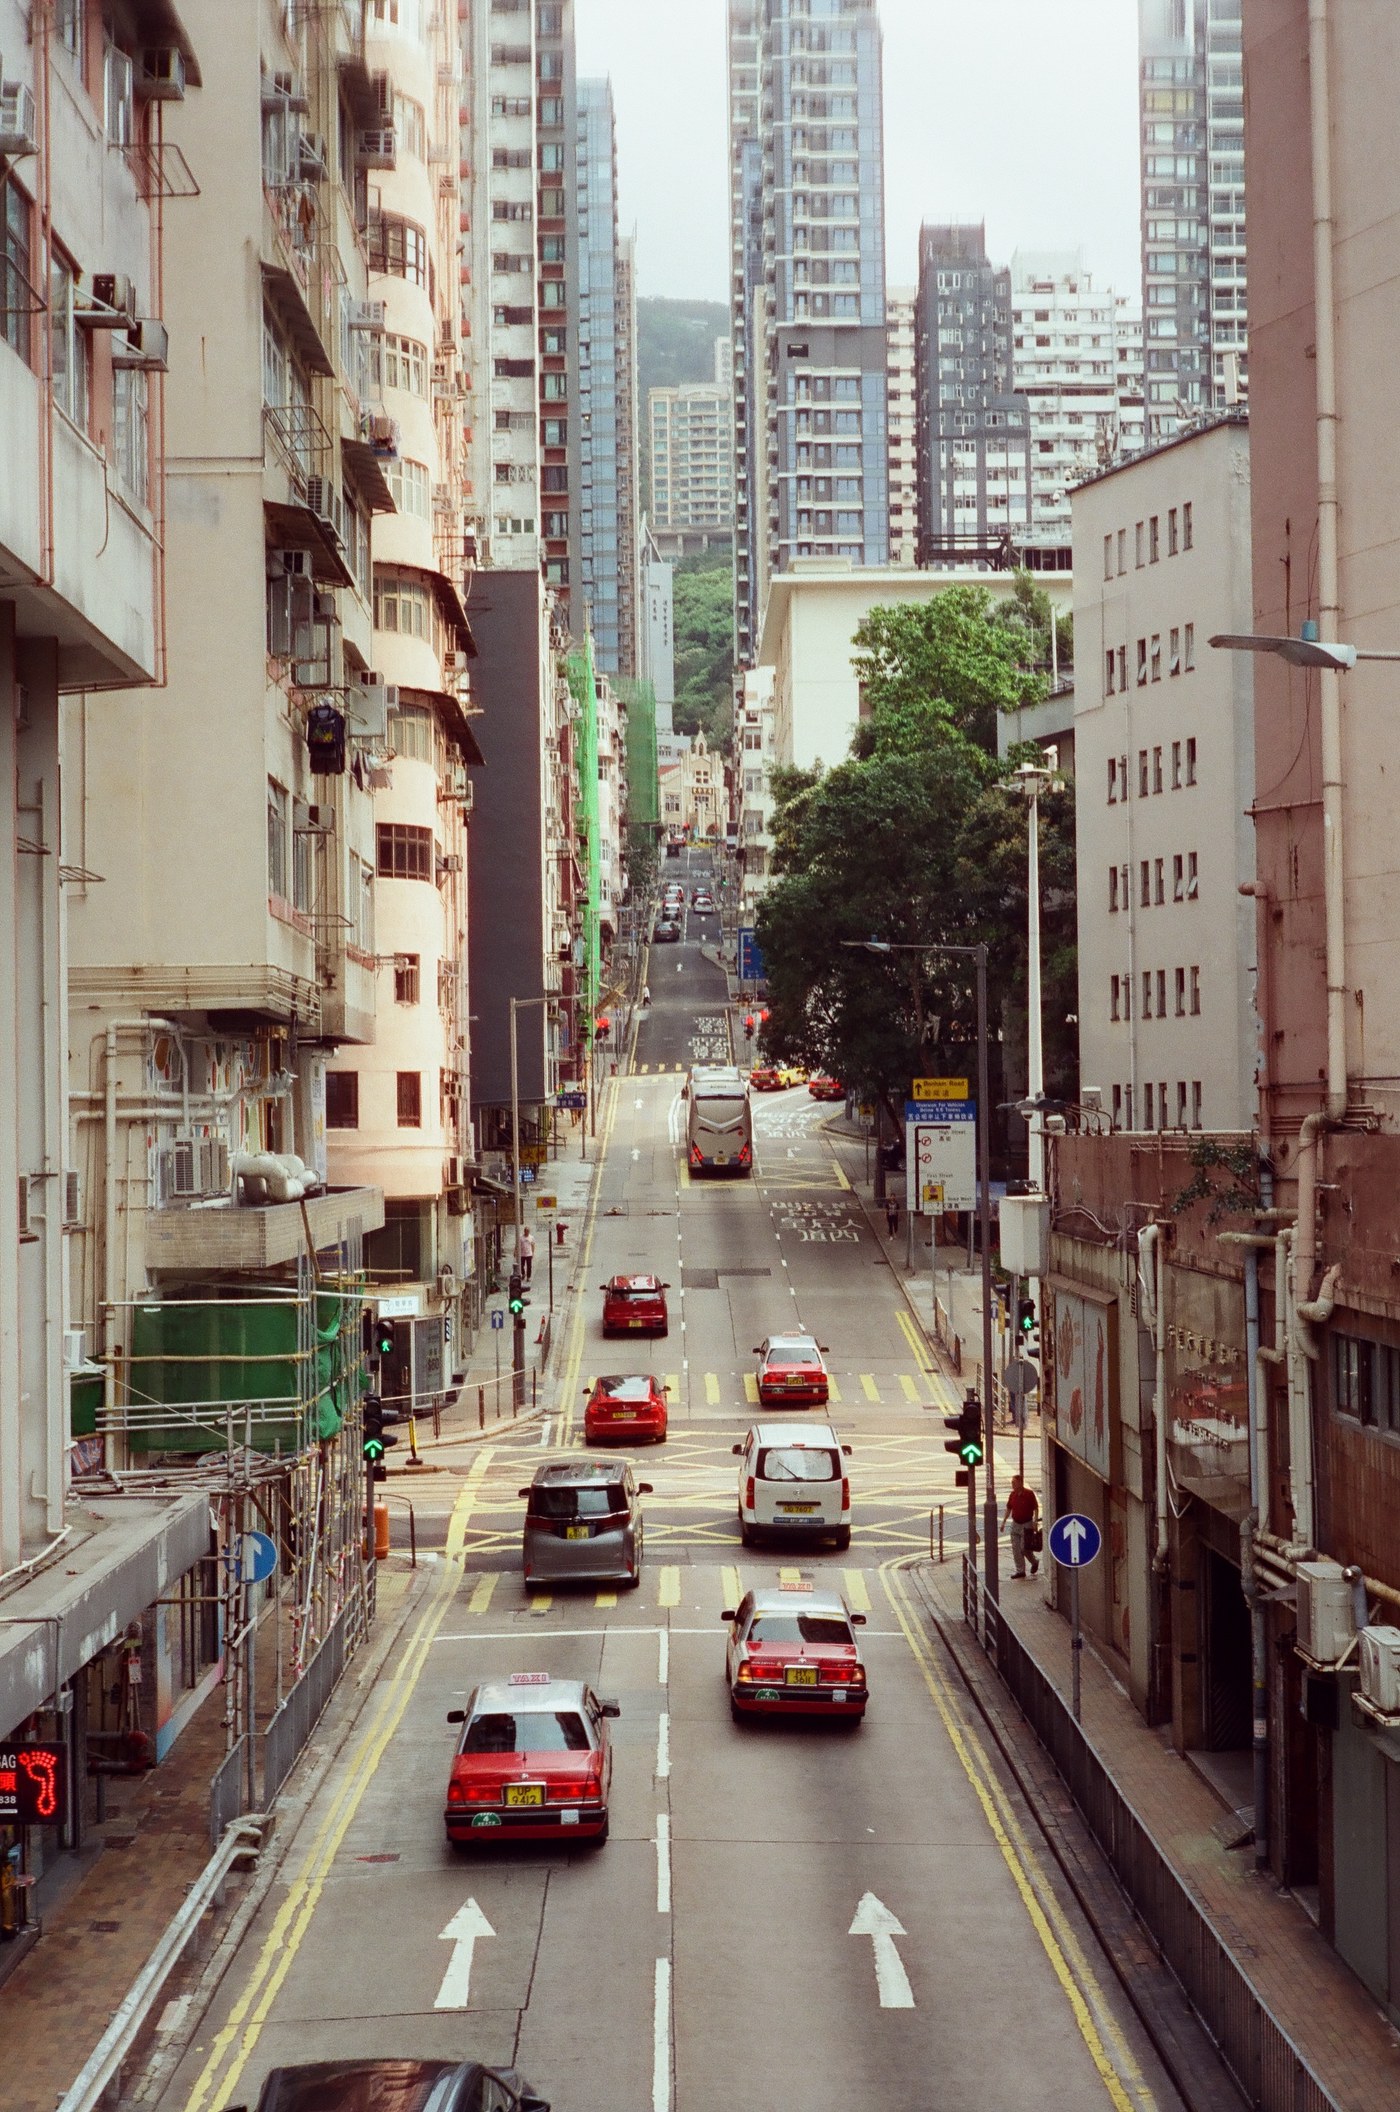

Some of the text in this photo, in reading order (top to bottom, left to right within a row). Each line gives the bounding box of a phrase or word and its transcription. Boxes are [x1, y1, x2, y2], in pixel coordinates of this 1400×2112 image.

[513, 1674, 547, 1683] TAXI
[517, 1786, 531, 1796] UP
[512, 1795, 537, 1805] 9412
